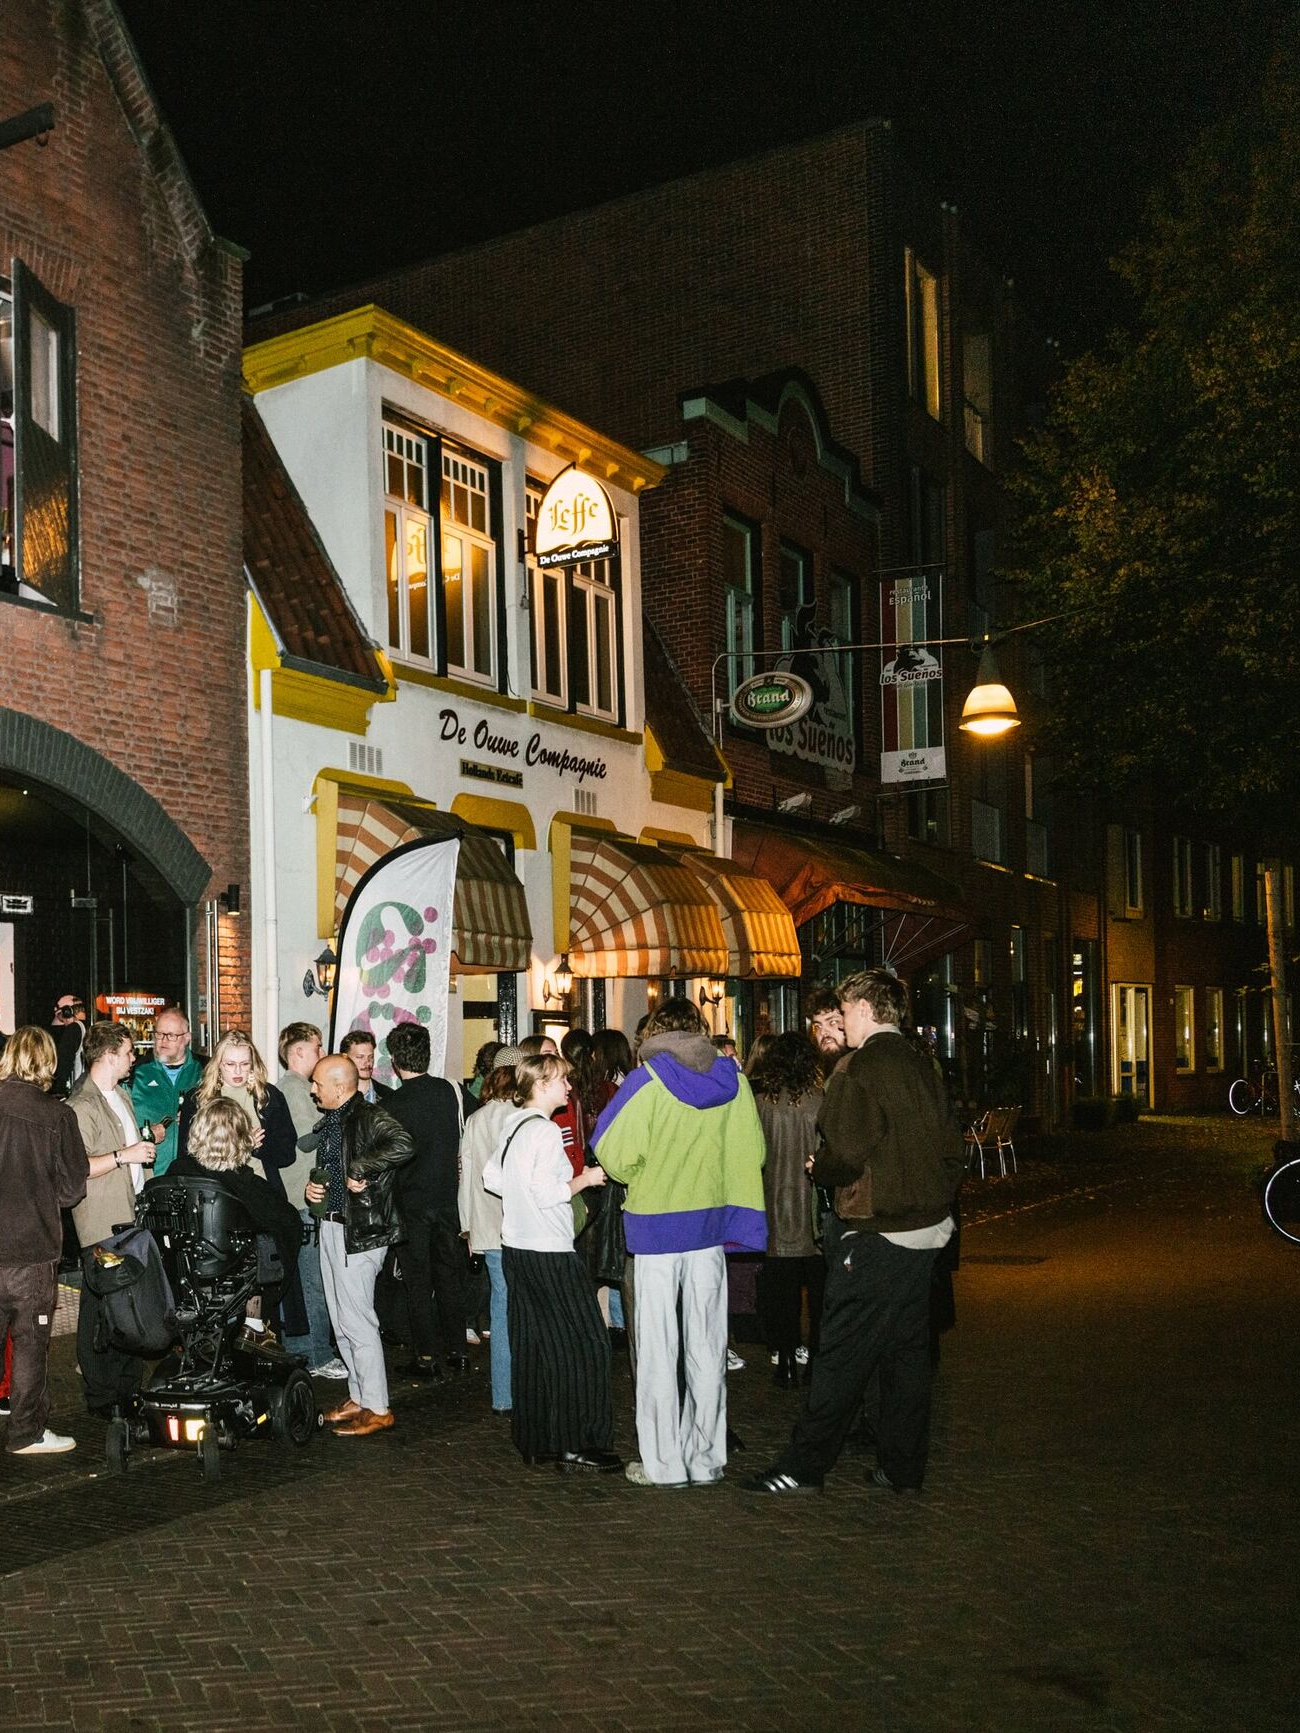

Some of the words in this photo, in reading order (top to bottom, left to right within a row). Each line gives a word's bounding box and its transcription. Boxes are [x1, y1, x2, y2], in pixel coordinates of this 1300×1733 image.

[549, 493, 598, 536] Leffe
[540, 556, 550, 564] De
[551, 553, 571, 561] Ouwe
[572, 545, 609, 558] Compagnie
[889, 591, 931, 605] Español
[881, 674, 897, 684] los
[900, 668, 942, 681] Sueños
[747, 689, 790, 707] Brand
[439, 708, 466, 744] De
[474, 719, 519, 757] Ouwe
[526, 733, 607, 783] Compagnie
[797, 720, 854, 765] Sueños
